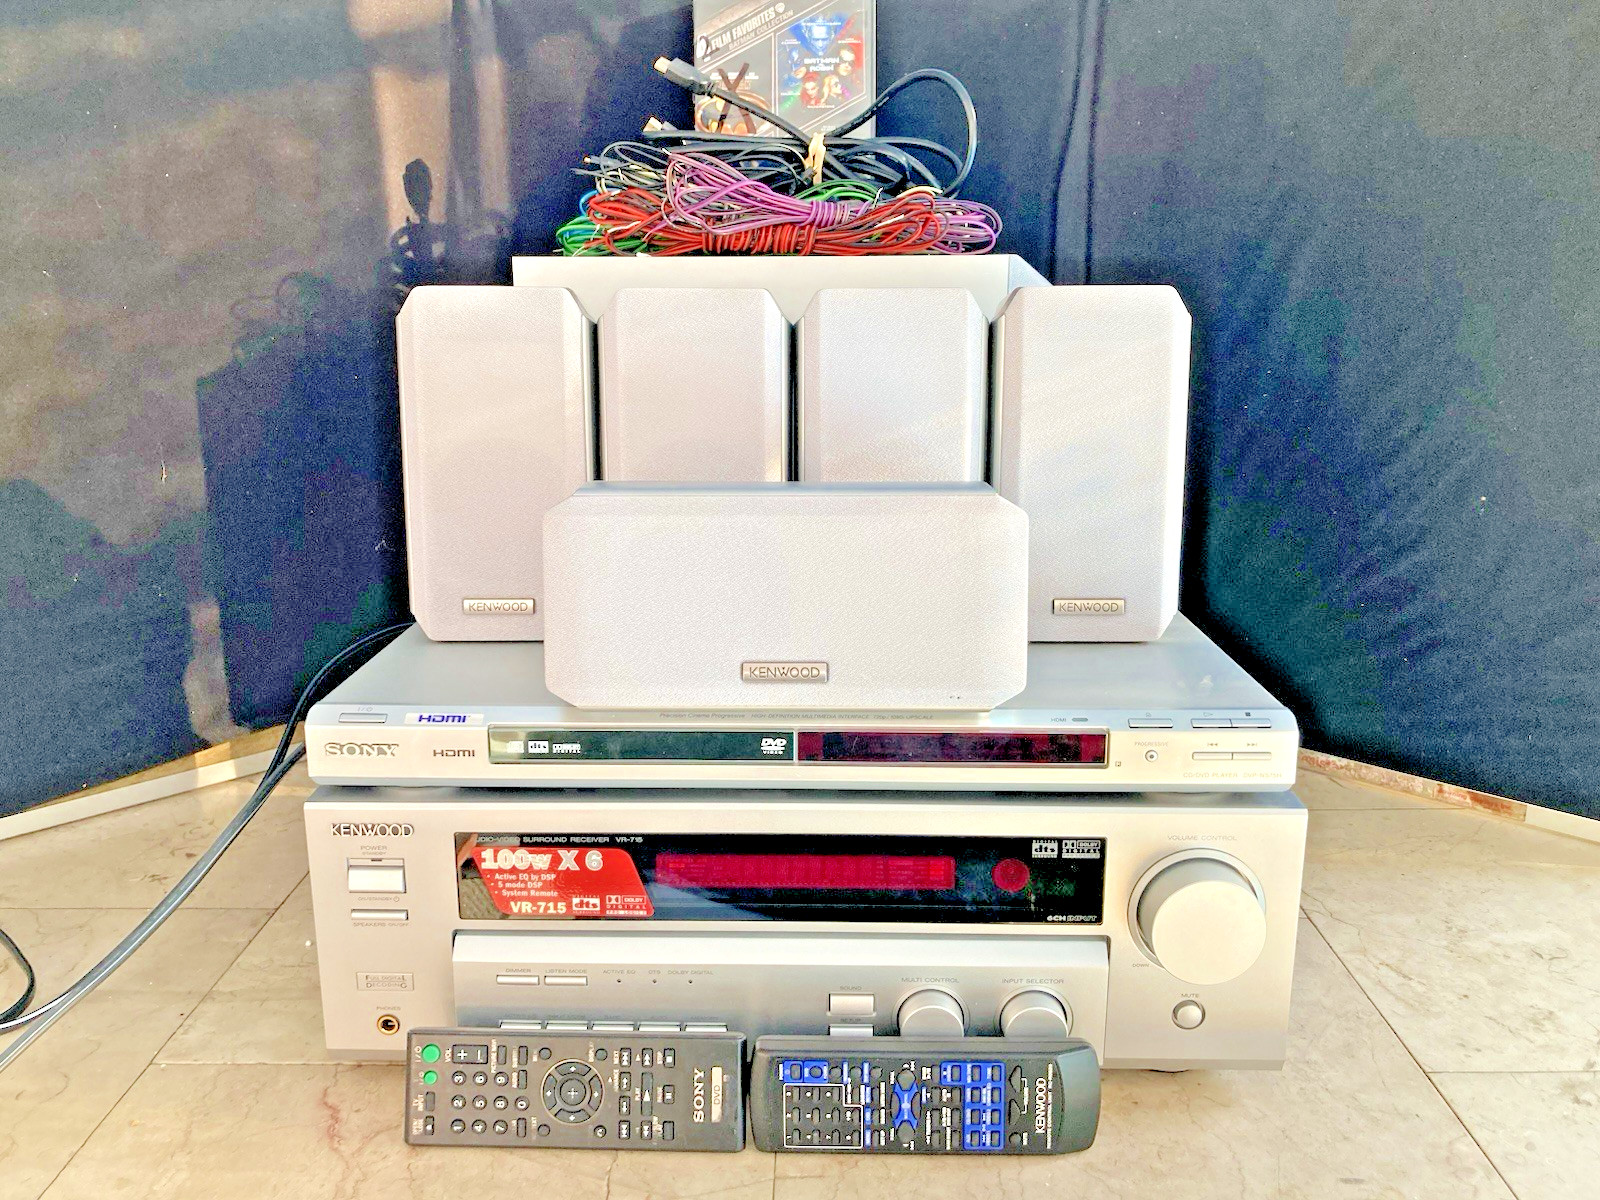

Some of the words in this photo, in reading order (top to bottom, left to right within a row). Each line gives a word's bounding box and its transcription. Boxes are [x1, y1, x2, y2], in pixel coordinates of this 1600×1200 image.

[711, 31, 731, 51] FILM
[731, 6, 776, 40] FAVORITES
[728, 32, 755, 51] BATMAN
[756, 9, 794, 35] COLLECTION
[468, 602, 528, 612] KENWOOD
[1059, 602, 1119, 612] KENWOOD
[749, 666, 820, 678] KENWOOD
[418, 714, 467, 723] HDMI
[761, 737, 787, 747] DVD
[324, 742, 399, 758] SONY
[433, 749, 476, 758] HDMI
[330, 823, 415, 837] KENWOOD
[522, 836, 568, 844] SURROUND
[570, 836, 610, 844] RECEIVER
[1033, 844, 1056, 853] dts
[585, 850, 604, 871] 6
[519, 873, 529, 881] EQ
[530, 873, 539, 882] by
[540, 873, 556, 881] DSP
[505, 881, 526, 889] mode
[527, 881, 543, 889] DSP
[501, 889, 529, 897] System
[530, 889, 558, 897] Remote
[510, 900, 567, 914] VR-715
[573, 899, 600, 909] dts
[454, 1075, 463, 1083] 3
[475, 1075, 484, 1083] 6
[498, 1075, 506, 1083] 9
[693, 1068, 705, 1123] SONY
[713, 1085, 721, 1105] DVD
[454, 1098, 463, 1107] 2
[475, 1099, 484, 1108] 5
[497, 1099, 505, 1108] 8
[517, 1100, 526, 1108] 0
[1035, 1077, 1046, 1134] KENWOOD
[453, 1123, 462, 1131] 1
[474, 1122, 483, 1132] 4
[496, 1123, 505, 1132] 7
